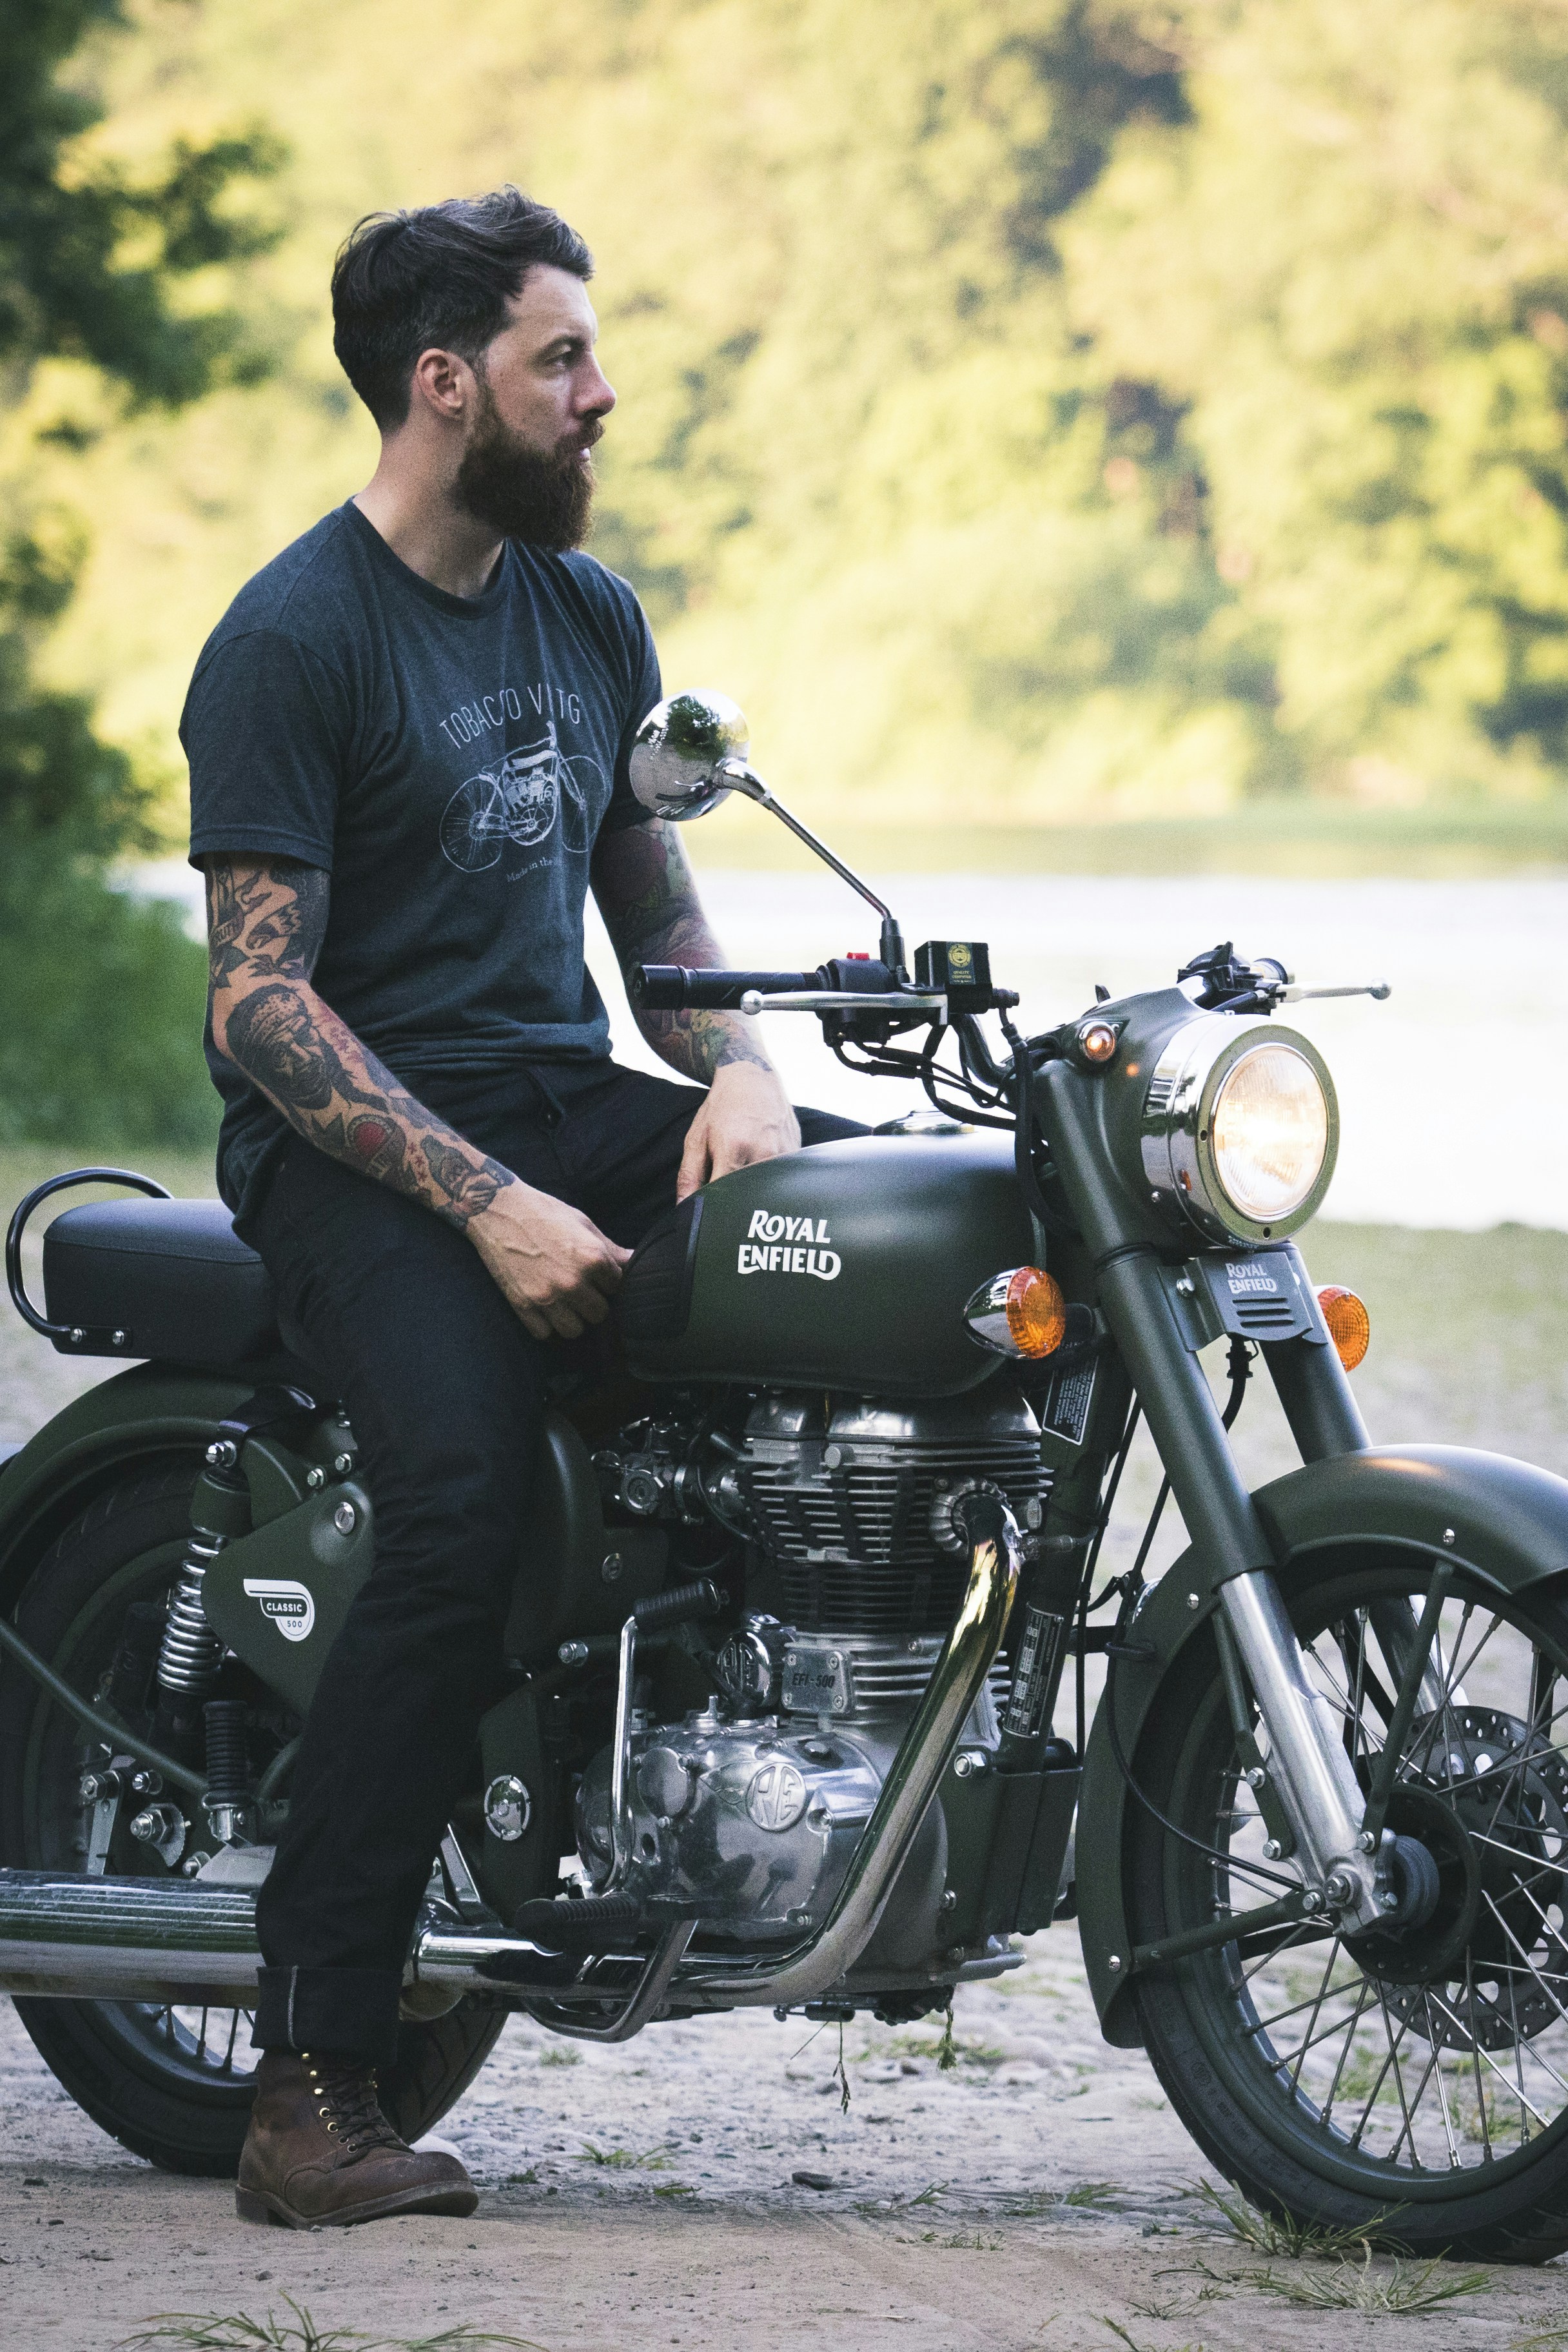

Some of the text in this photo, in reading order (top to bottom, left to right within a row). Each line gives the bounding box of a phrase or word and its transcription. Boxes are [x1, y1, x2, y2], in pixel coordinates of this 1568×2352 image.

[747, 1210, 830, 1244] ROYAL
[738, 1244, 841, 1280] ENFIELD
[1225, 1262, 1268, 1279] ROYAL
[1227, 1278, 1277, 1294] ENFIELD
[266, 1603, 302, 1612] CLASSIC
[792, 1672, 836, 1689] EFI-500
